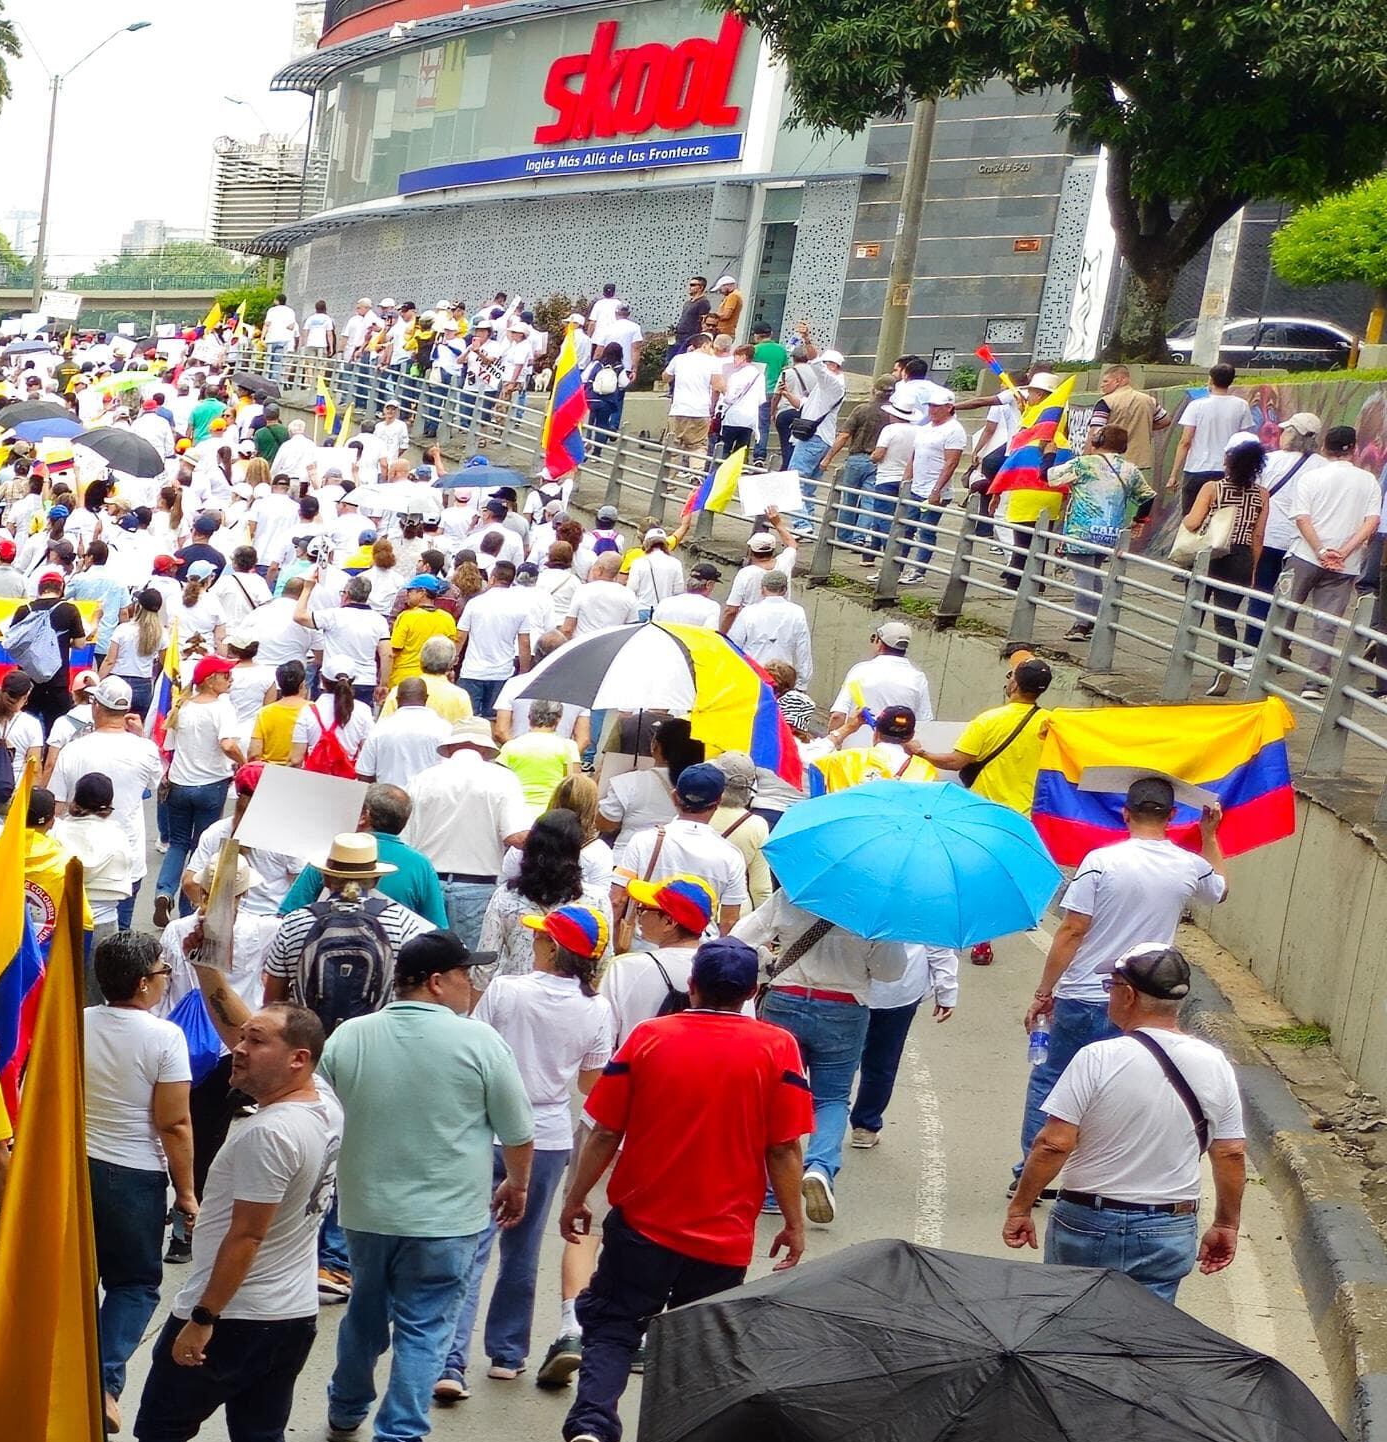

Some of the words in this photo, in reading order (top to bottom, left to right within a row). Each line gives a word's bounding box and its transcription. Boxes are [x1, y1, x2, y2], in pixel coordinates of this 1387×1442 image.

[525, 156, 555, 173] Inglés
[558, 155, 580, 168] Más
[583, 153, 606, 166] Allá
[610, 151, 624, 164] de
[628, 149, 645, 162] las
[649, 145, 710, 160] Fronteras
